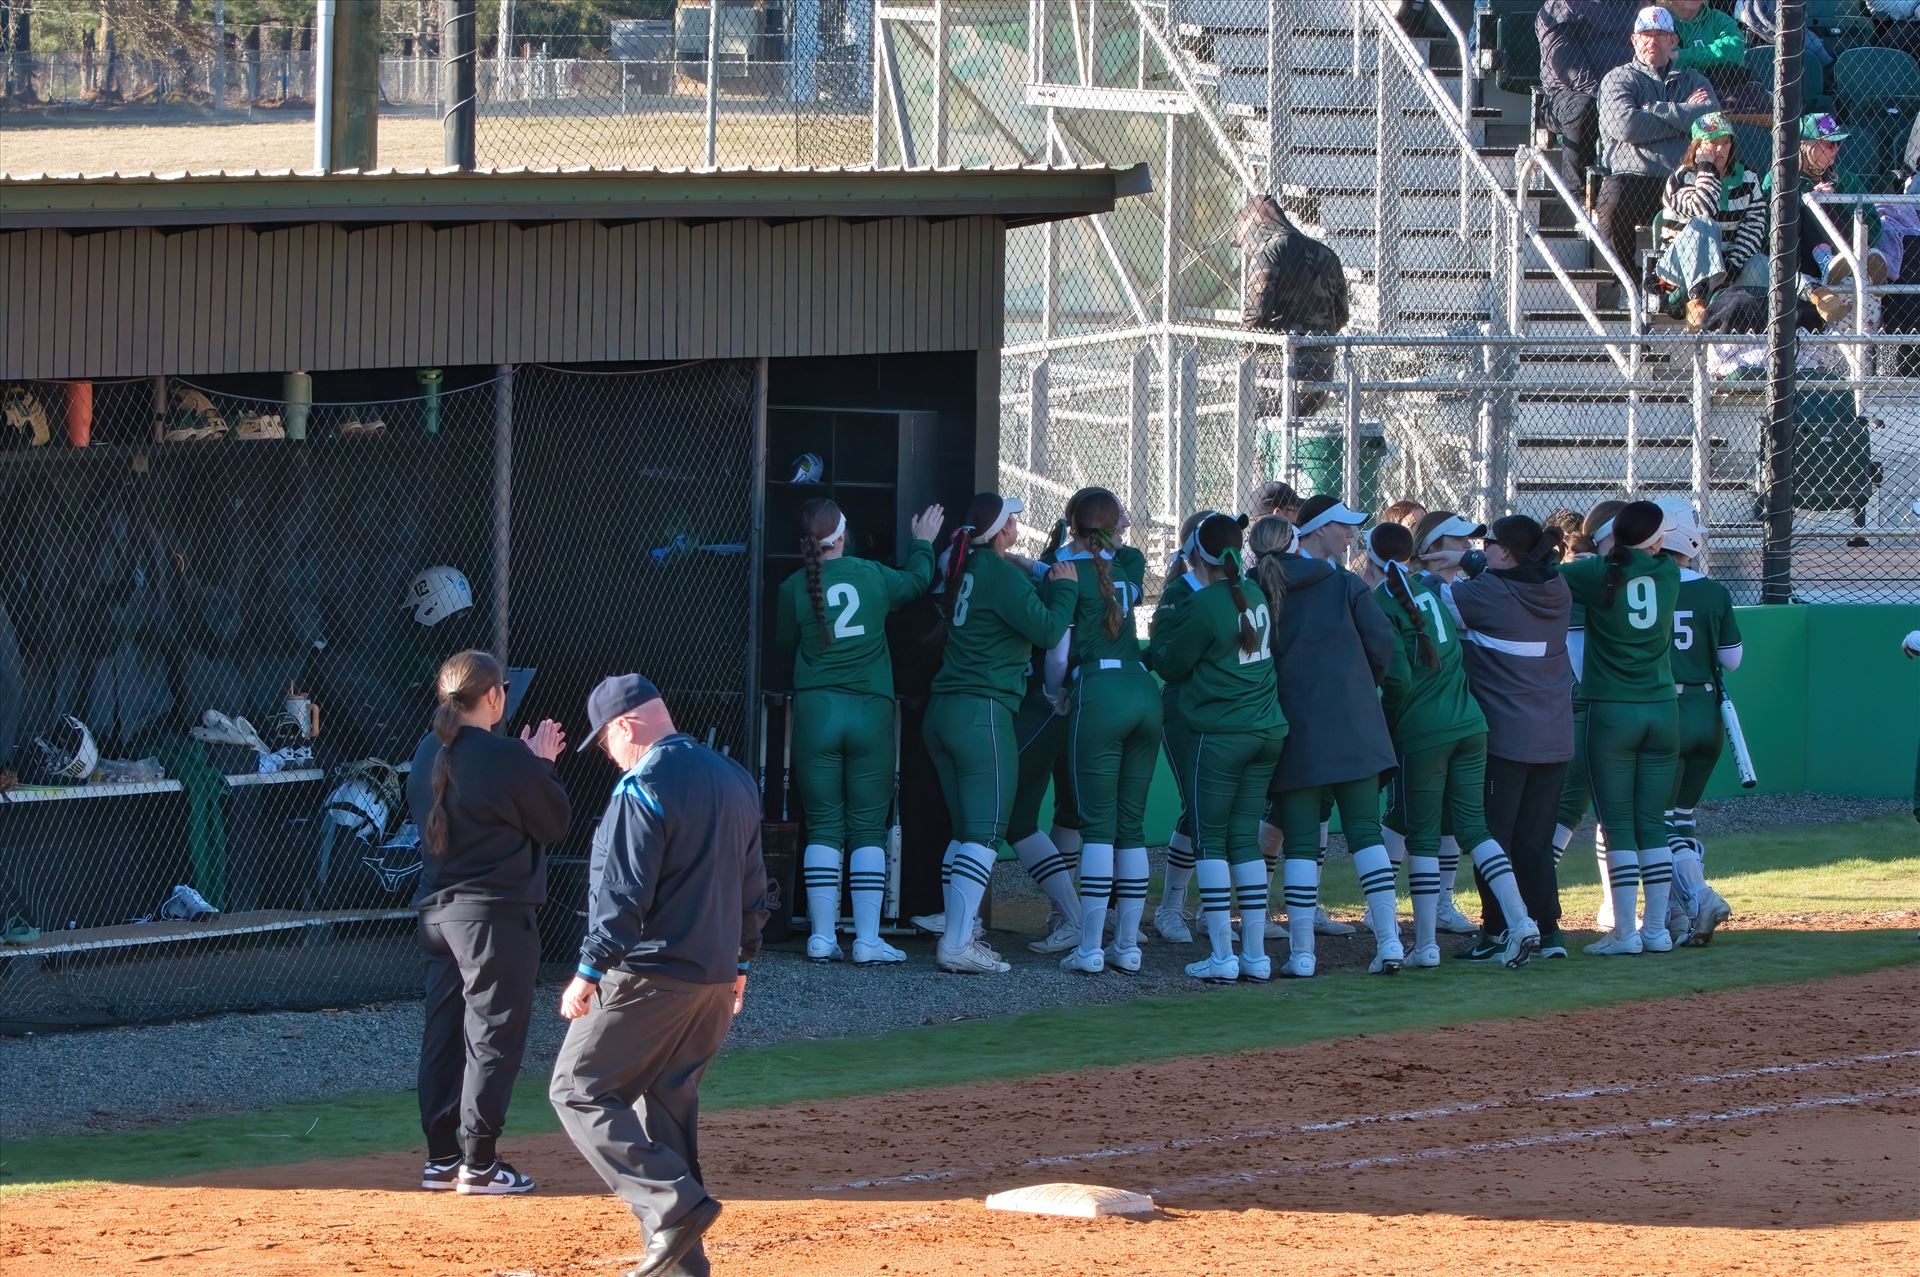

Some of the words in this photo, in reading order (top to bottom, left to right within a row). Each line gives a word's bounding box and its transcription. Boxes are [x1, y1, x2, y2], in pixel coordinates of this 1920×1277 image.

[826, 582, 865, 639] 2
[952, 571, 975, 627] 8
[1414, 591, 1448, 644] 7
[1626, 575, 1658, 630] 9
[1673, 610, 1693, 650] 5
